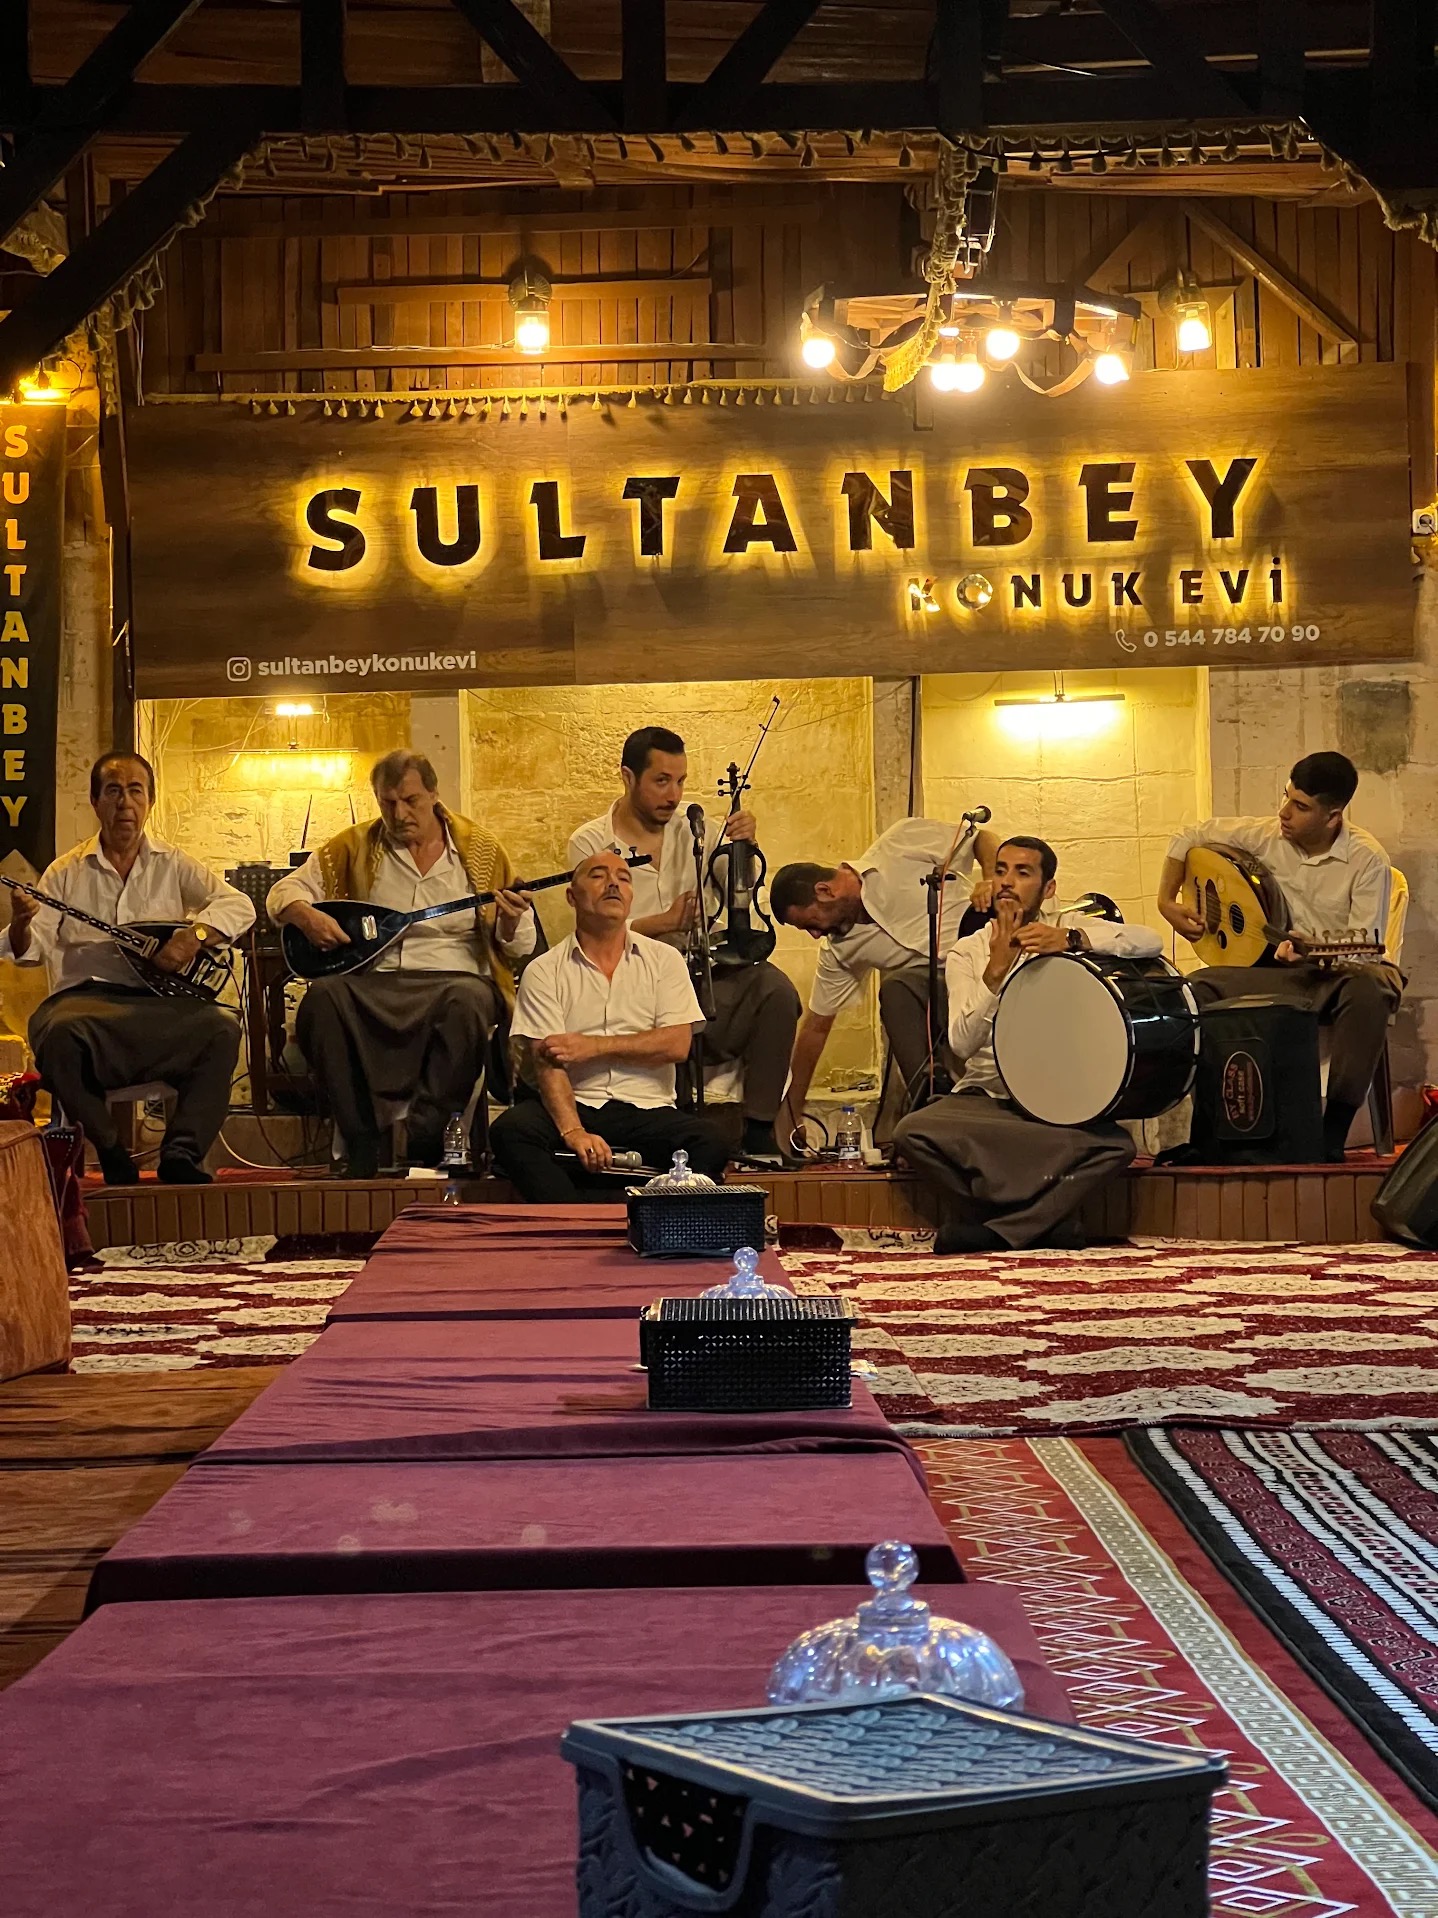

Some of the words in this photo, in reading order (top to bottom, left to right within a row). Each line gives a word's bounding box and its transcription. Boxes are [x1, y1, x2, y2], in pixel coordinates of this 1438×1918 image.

[306, 457, 1259, 571] SULTANBEY
[907, 571, 1143, 612] KONUK
[1178, 556, 1283, 604] EVİ
[1, 425, 30, 827] SULTANBEY
[1143, 631, 1159, 648] 0
[1165, 629, 1206, 647] 544
[1211, 627, 1252, 645] 784
[1257, 626, 1286, 643] 70
[1291, 624, 1321, 642] 90
[258, 650, 477, 677] sultanbeykonukevi
